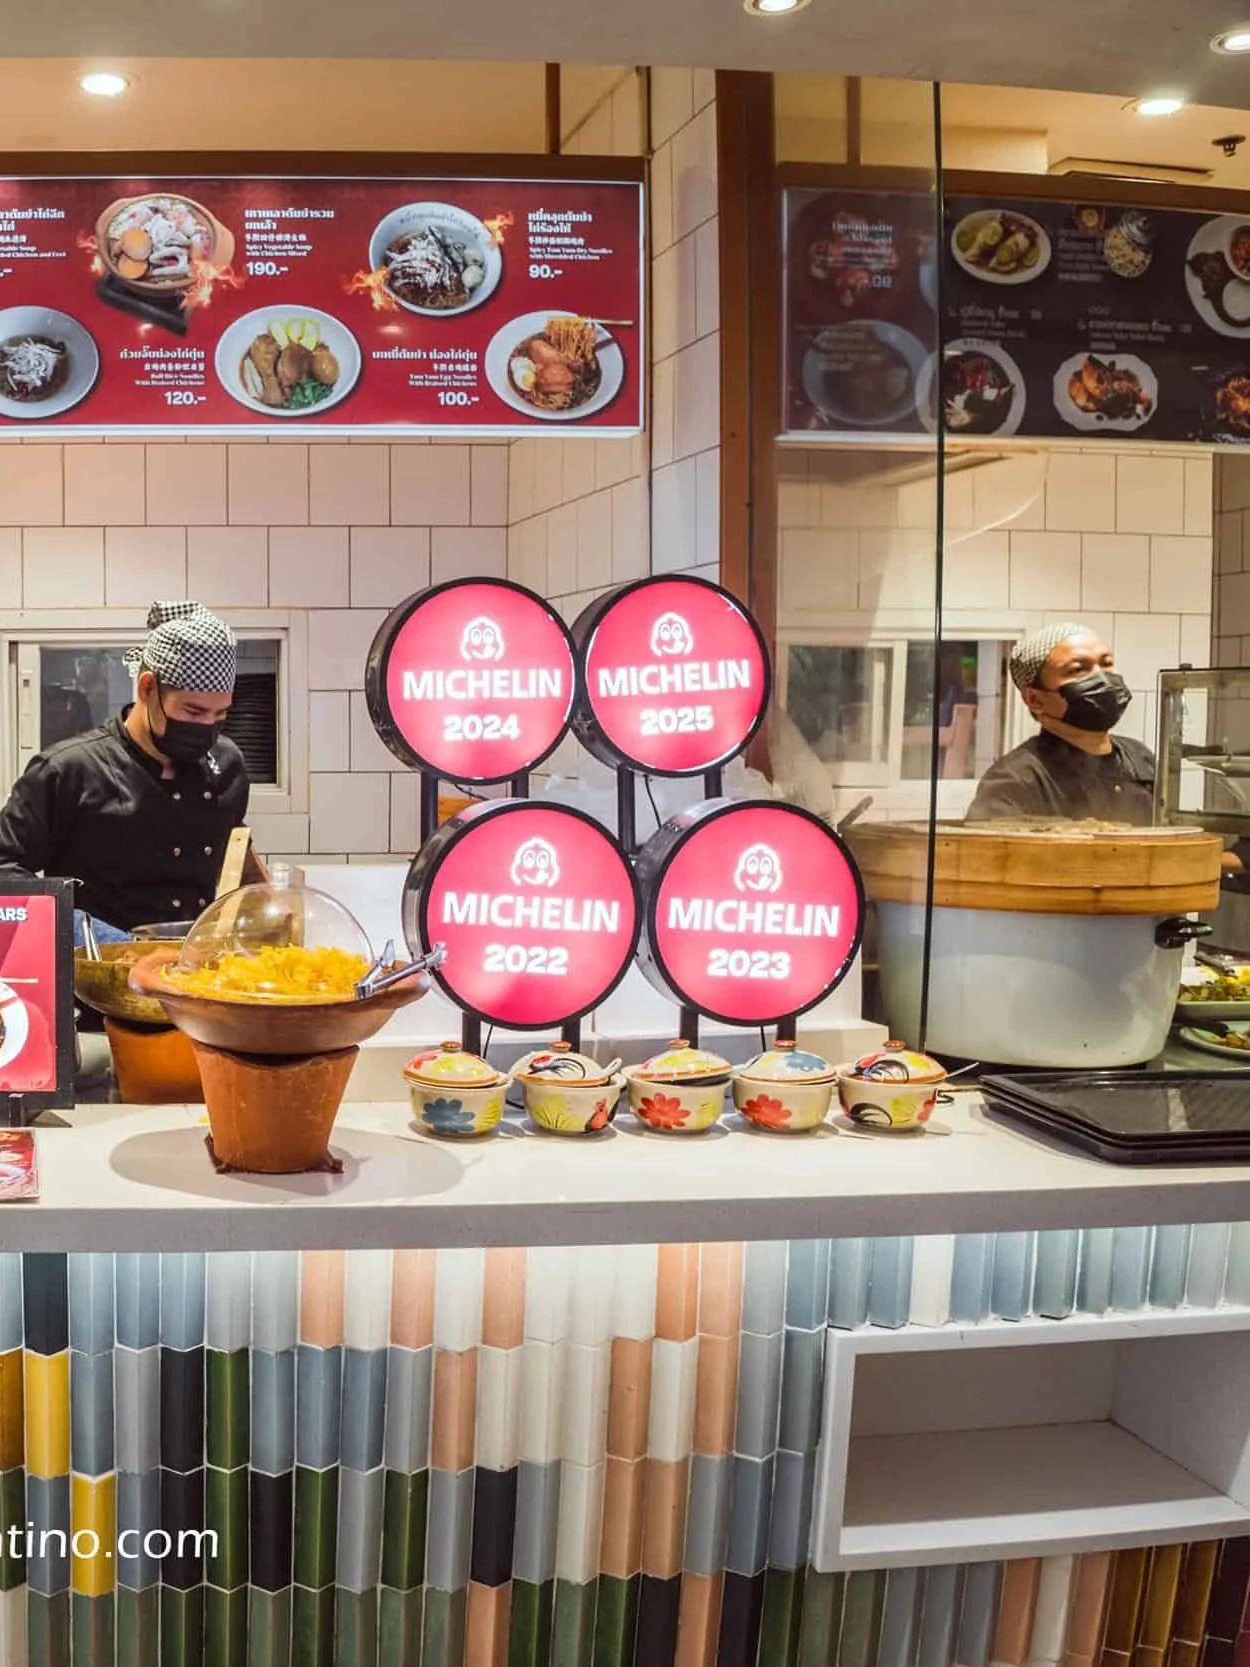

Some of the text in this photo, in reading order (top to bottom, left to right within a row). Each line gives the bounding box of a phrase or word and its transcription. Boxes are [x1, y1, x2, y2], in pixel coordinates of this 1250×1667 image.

[529, 264, 563, 279] 90.-
[165, 391, 206, 405] 120.-
[438, 391, 480, 406] 100.-
[402, 668, 562, 700] MICHELIN
[598, 659, 750, 697] MICHELIN
[443, 714, 521, 741] 2024
[640, 706, 714, 735] 2025
[442, 892, 620, 933] MICHELIN
[667, 897, 840, 938] MICHELIN
[483, 944, 568, 975] 2022
[707, 949, 791, 979] 2023
